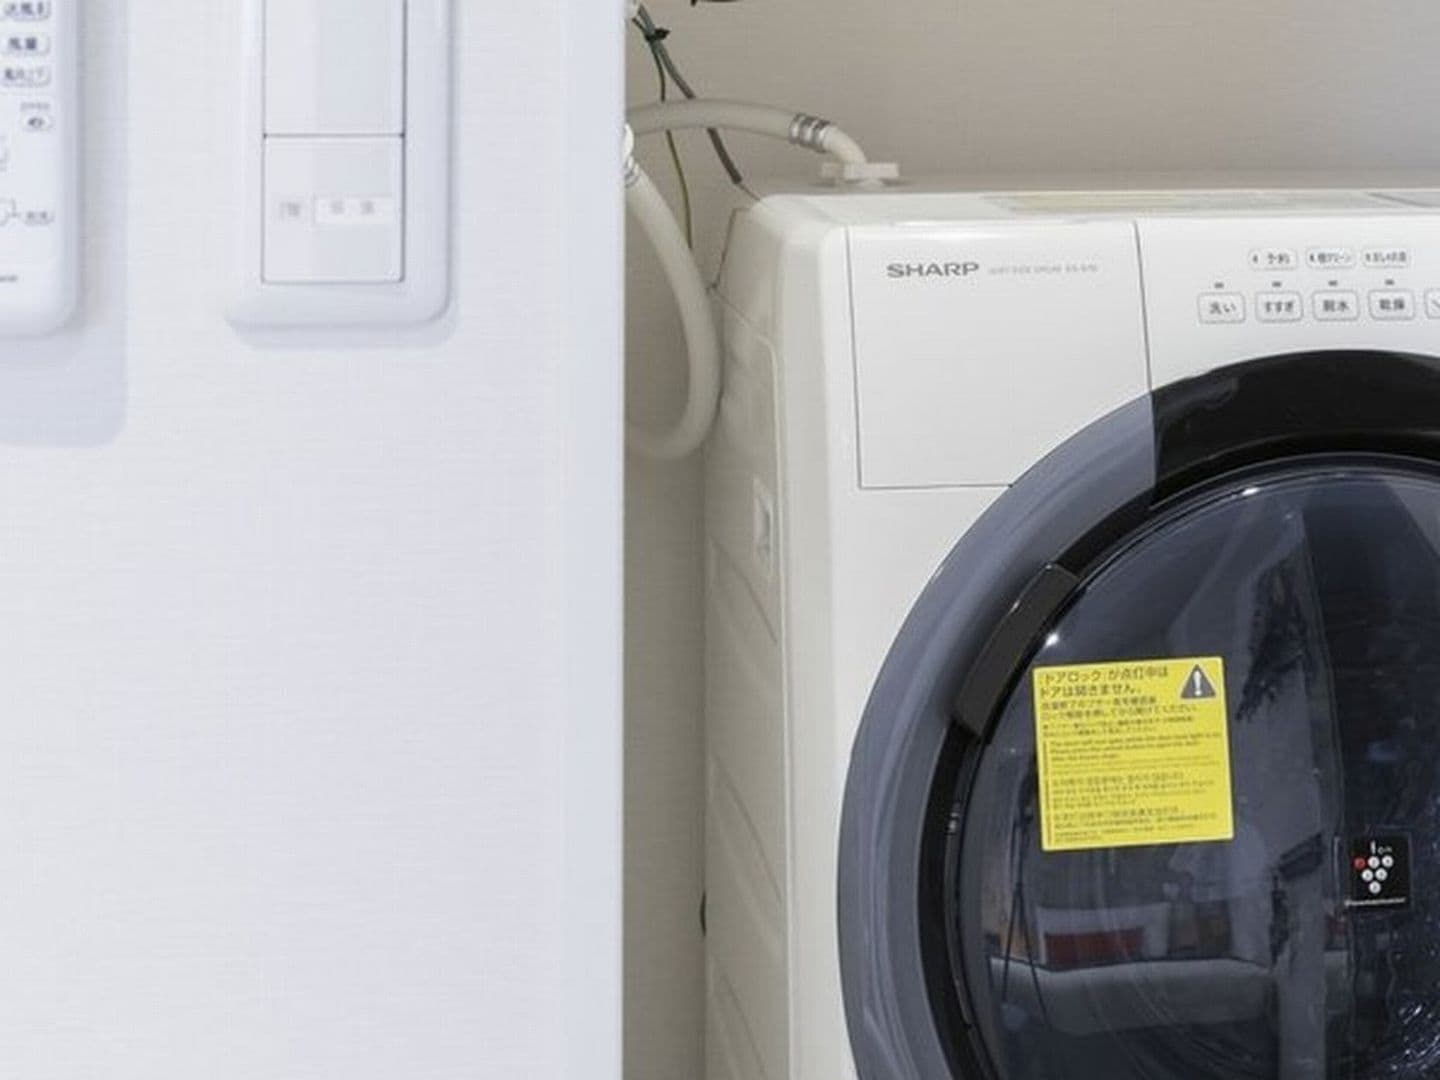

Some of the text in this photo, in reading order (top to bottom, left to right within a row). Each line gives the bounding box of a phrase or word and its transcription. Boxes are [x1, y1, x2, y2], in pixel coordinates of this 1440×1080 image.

[887, 262, 979, 278] SHARP
[1209, 301, 1237, 315] 洗い
[1265, 300, 1294, 314] すすぎ
